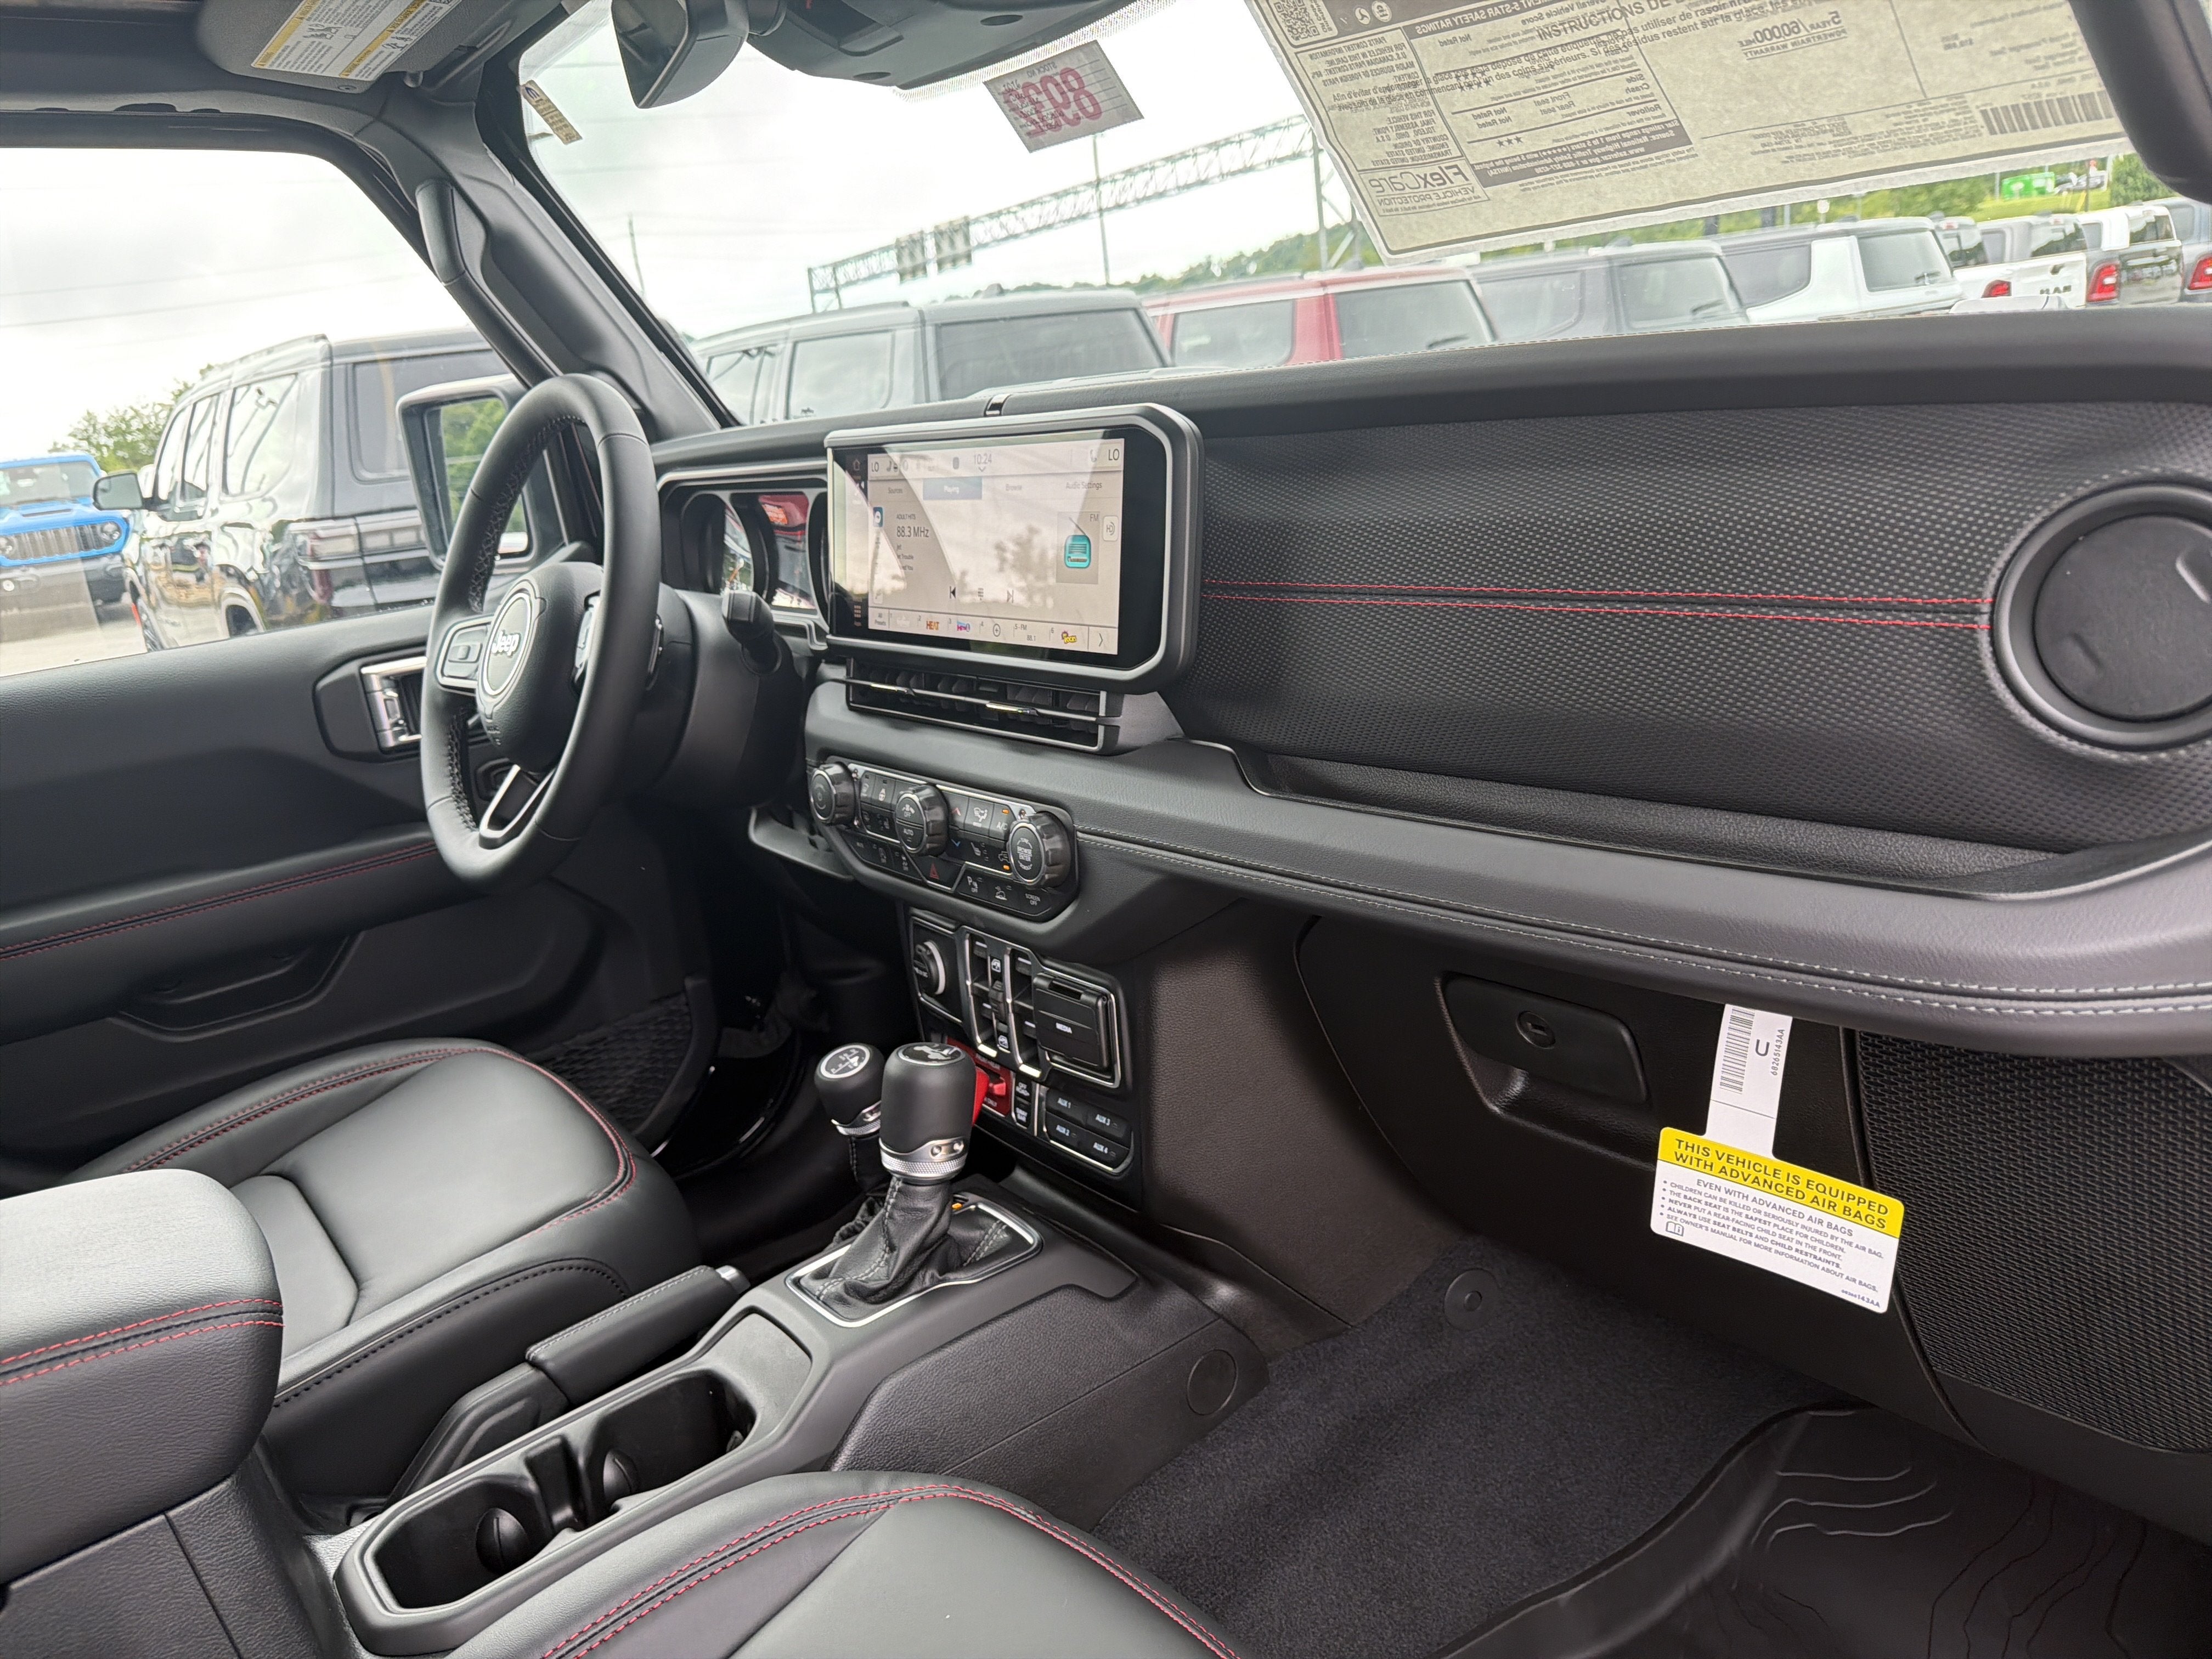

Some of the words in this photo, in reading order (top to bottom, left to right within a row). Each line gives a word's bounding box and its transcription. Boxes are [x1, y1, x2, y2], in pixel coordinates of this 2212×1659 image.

[1640, 15, 1676, 31] utiliser
[1678, 11, 1692, 21] de
[1662, 21, 1699, 38] restent
[871, 462, 879, 472] LO
[974, 454, 992, 465] 10:24
[1108, 449, 1120, 461] LO
[1081, 481, 1102, 490] Settings
[896, 526, 911, 538] 88.3
[913, 527, 929, 538] MHz
[926, 620, 940, 631] HEAT
[492, 631, 520, 656] Jeep
[1025, 893, 1041, 902] SCREEN
[1056, 1022, 1073, 1034] MEDIA
[1756, 1039, 1770, 1057] U
[1058, 1098, 1068, 1107] AUX
[1096, 1114, 1106, 1124] AUX
[1056, 1125, 1065, 1134] AUX
[1093, 1142, 1103, 1152] AUX
[1675, 1138, 1710, 1156] THIS
[1716, 1150, 1781, 1179] VEHICLE
[1786, 1172, 1801, 1185] IS
[1805, 1179, 1888, 1215] EQUIPPED
[1674, 1151, 1713, 1171] WITH
[1719, 1166, 1805, 1199] ADVANCED
[1810, 1195, 1837, 1212] AIR
[1842, 1205, 1886, 1228] BAGS
[1696, 1178, 1722, 1192] EVEN
[1724, 1187, 1749, 1201] WITH
[1751, 1197, 1804, 1218] ADVANCED
[1807, 1215, 1824, 1226] AIR
[1826, 1221, 1853, 1237] BAGS
[1668, 1198, 1692, 1209] NEVER
[1693, 1205, 1706, 1214] PUT
[1713, 1211, 1755, 1229] REAR-FACING
[1756, 1226, 1777, 1237] CHILD
[1778, 1233, 1794, 1243] SEAT
[1804, 1242, 1817, 1251] THE
[1818, 1248, 1842, 1261] FRONT.
[1669, 1182, 1702, 1195] CHILDREN
[1703, 1192, 1717, 1200] CAN
[1728, 1200, 1751, 1211] KILLED
[1763, 1211, 1799, 1227] SERIOUSLY
[1800, 1224, 1829, 1237] INJURED
[1840, 1237, 1853, 1247] THE
[1854, 1244, 1866, 1252] AIR
[1867, 1248, 1883, 1259] BAG.
[1669, 1189, 1681, 1198] THE
[1683, 1194, 1702, 1204] BACK
[1704, 1200, 1722, 1210] SEAT
[1730, 1209, 1743, 1217] THE
[1745, 1214, 1770, 1226] SAFEST
[1773, 1223, 1793, 1234] PLACE
[1795, 1231, 1809, 1239] FOR
[1809, 1235, 1846, 1253] CHILDREN.
[1667, 1206, 1696, 1219] ALWAYS
[1698, 1215, 1711, 1224] USE
[1712, 1220, 1730, 1229] SEAT
[1731, 1226, 1753, 1237] BELTS
[1754, 1234, 1769, 1243] AND
[1770, 1239, 1793, 1250] CHILD
[1795, 1248, 1841, 1268] RESTRAINTS.
[1679, 1218, 1708, 1231] OWNER'S
[1710, 1227, 1737, 1241] MANUAL
[1739, 1237, 1752, 1245] FOR
[1753, 1242, 1772, 1252] MORE
[1774, 1249, 1819, 1269] INFORMATION
[1820, 1266, 1844, 1278] ABOUT
[1844, 1275, 1857, 1284] AIR
[1858, 1280, 1878, 1292] BAGS.
